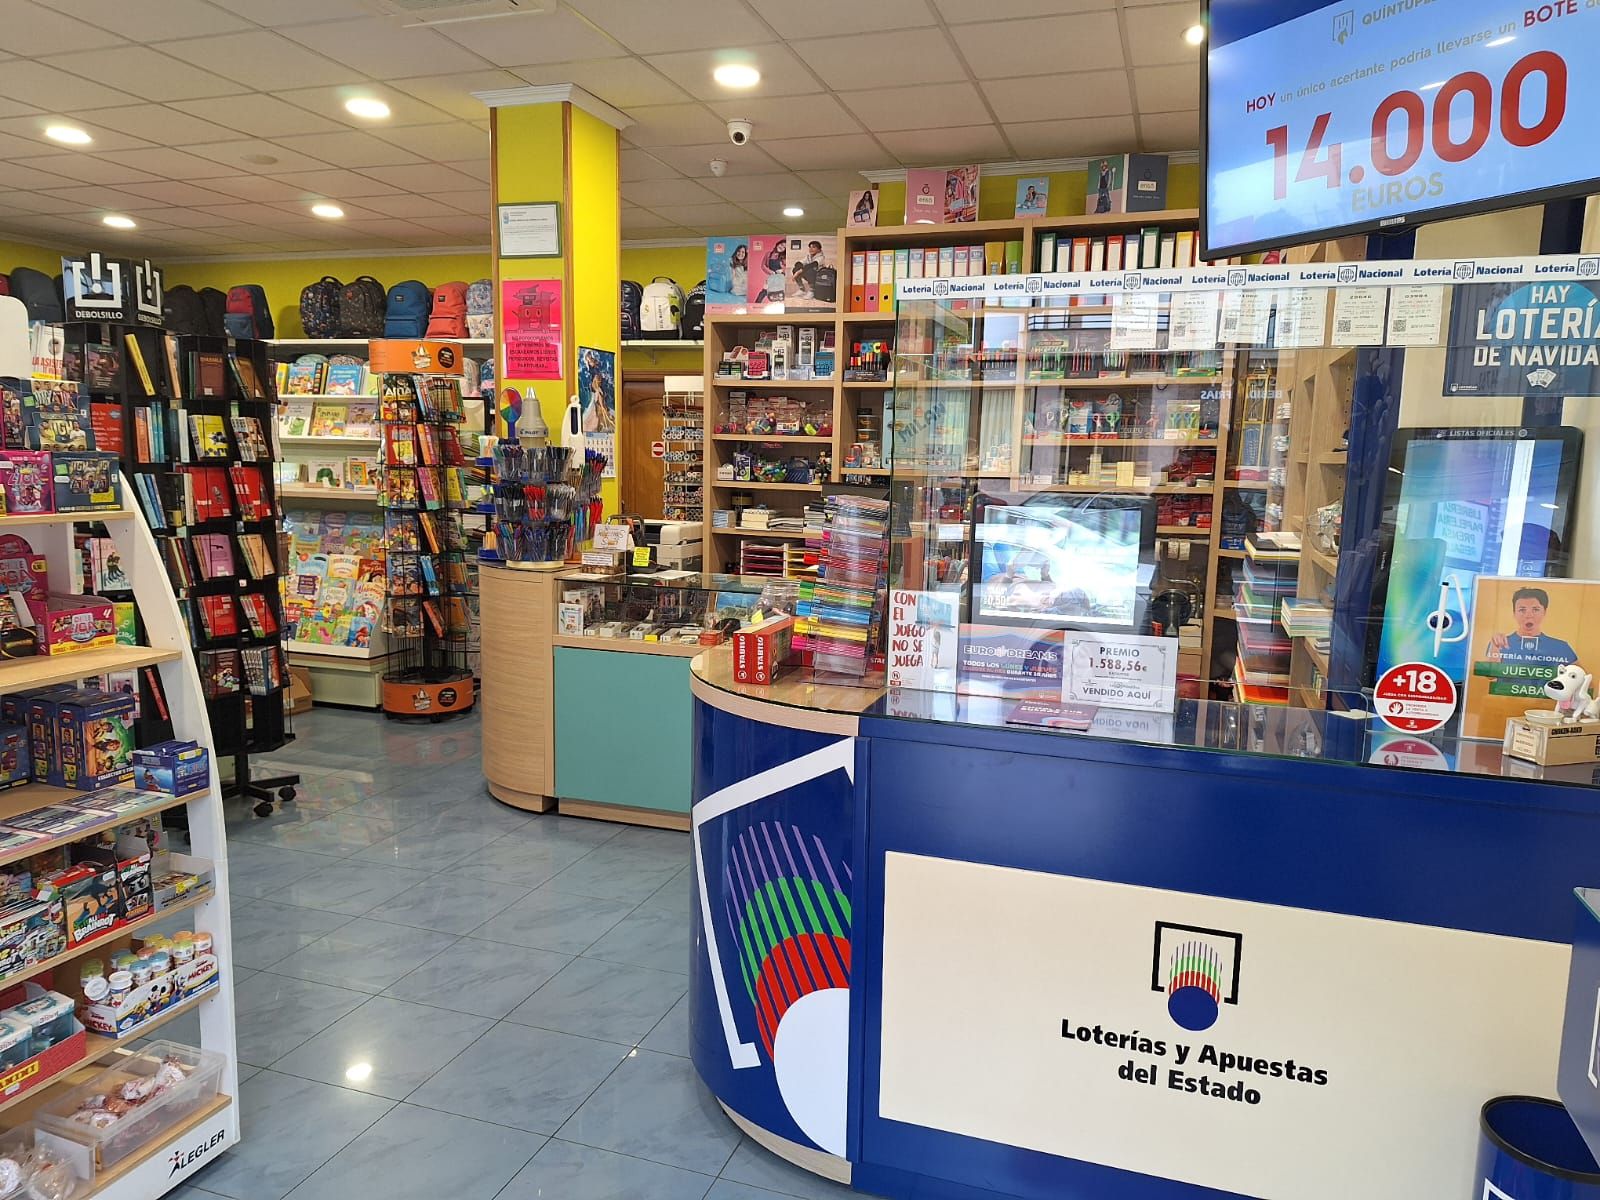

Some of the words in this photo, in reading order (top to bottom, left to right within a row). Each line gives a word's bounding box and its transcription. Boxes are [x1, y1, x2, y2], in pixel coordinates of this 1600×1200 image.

[1246, 92, 1276, 113] HOY
[1280, 92, 1293, 103] un
[1330, 62, 1385, 87] acertante
[1437, 28, 1492, 54] llevarse
[1499, 21, 1516, 35] un
[1524, 0, 1578, 27] BOTE
[1266, 50, 1567, 201] 14.000
[1352, 172, 1444, 211] EUROS
[1359, 268, 1403, 278] Nacional
[1476, 265, 1523, 275] Nacional
[1143, 276, 1182, 286] Nacional
[1248, 272, 1289, 282] Nacional
[950, 283, 985, 293] Nacional
[1044, 280, 1081, 289] Nacional
[1531, 285, 1571, 304] HAY
[75, 310, 123, 320] DEBOLSILLO
[854, 342, 888, 353] POSCA
[1473, 346, 1502, 366] DE
[1510, 344, 1600, 366] NAVIDA
[894, 592, 916, 606] CON
[893, 607, 904, 620] EL
[893, 624, 926, 637] JUEGO
[892, 640, 909, 651] NO
[913, 639, 923, 652] SE
[1099, 646, 1140, 657] PREMIO
[964, 645, 995, 656] EURO
[1008, 648, 1058, 661] DREAMS
[1525, 654, 1569, 663] NACIONAL
[892, 655, 923, 667] JUEGA
[1089, 657, 1148, 671] 1.588,56€
[1502, 666, 1553, 678] JUEVES
[1393, 670, 1437, 693] +18
[1083, 687, 1124, 697] VENDIDO
[1127, 690, 1152, 700] AQUÍ
[1511, 684, 1545, 696] SABA
[188, 962, 214, 980] MICKEY
[1061, 1018, 1166, 1056] Loterías
[1175, 1044, 1190, 1065] y
[1198, 1044, 1328, 1085] Apuestas
[1118, 1060, 1157, 1085] del
[1168, 1069, 1261, 1105] Estado
